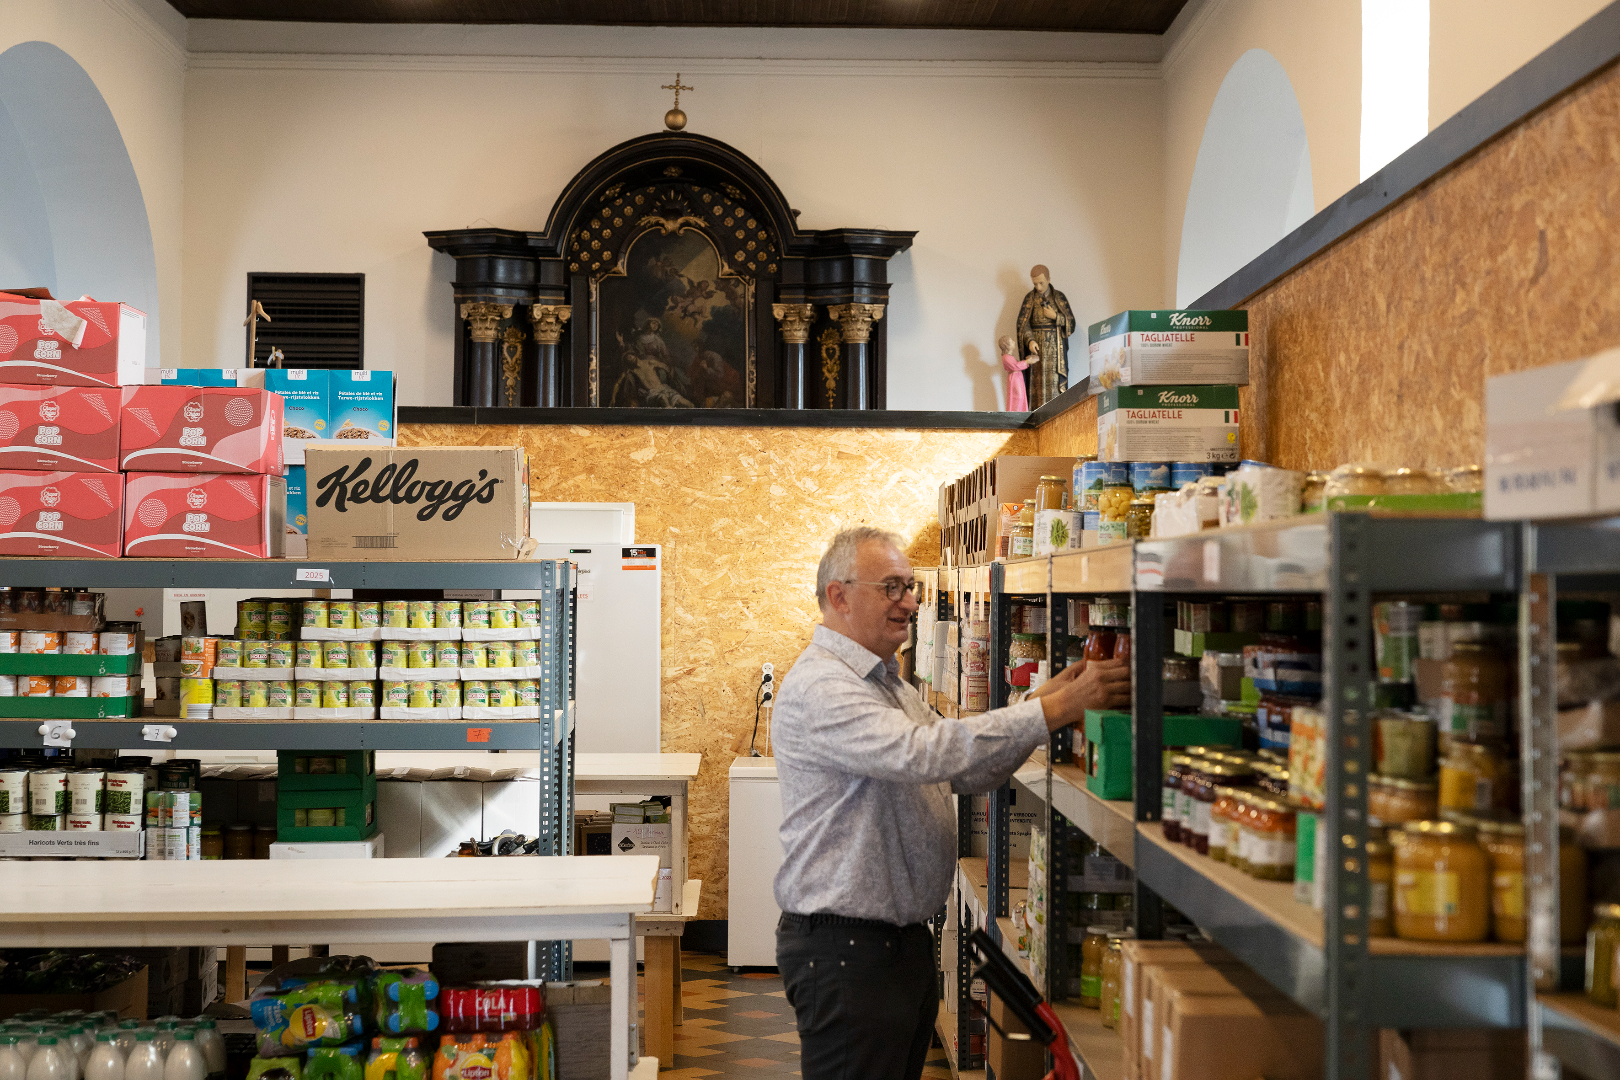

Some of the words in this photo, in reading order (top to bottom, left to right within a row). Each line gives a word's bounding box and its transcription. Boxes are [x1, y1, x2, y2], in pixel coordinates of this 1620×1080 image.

[1169, 313, 1212, 326] Knorr
[1140, 333, 1195, 342] TAGLIATELLE
[38, 340, 58, 350] POP
[34, 349, 61, 359] CORN
[1158, 390, 1199, 403] Knorr
[1126, 410, 1182, 419] TAGLIATELLE
[38, 426, 59, 436] POP
[183, 427, 204, 437] POP
[35, 435, 62, 445] CORN
[179, 436, 206, 446] CORN
[1212, 452, 1220, 460] kg
[316, 457, 500, 522] Kellogg's
[39, 512, 60, 521] POP
[186, 513, 207, 522] POP
[36, 521, 63, 530] CORN
[183, 522, 210, 532] CORN
[51, 726, 61, 740] 6
[476, 996, 506, 1010] COLA
[304, 1010, 314, 1035] Lipton
[463, 1068, 490, 1078] Lipton
